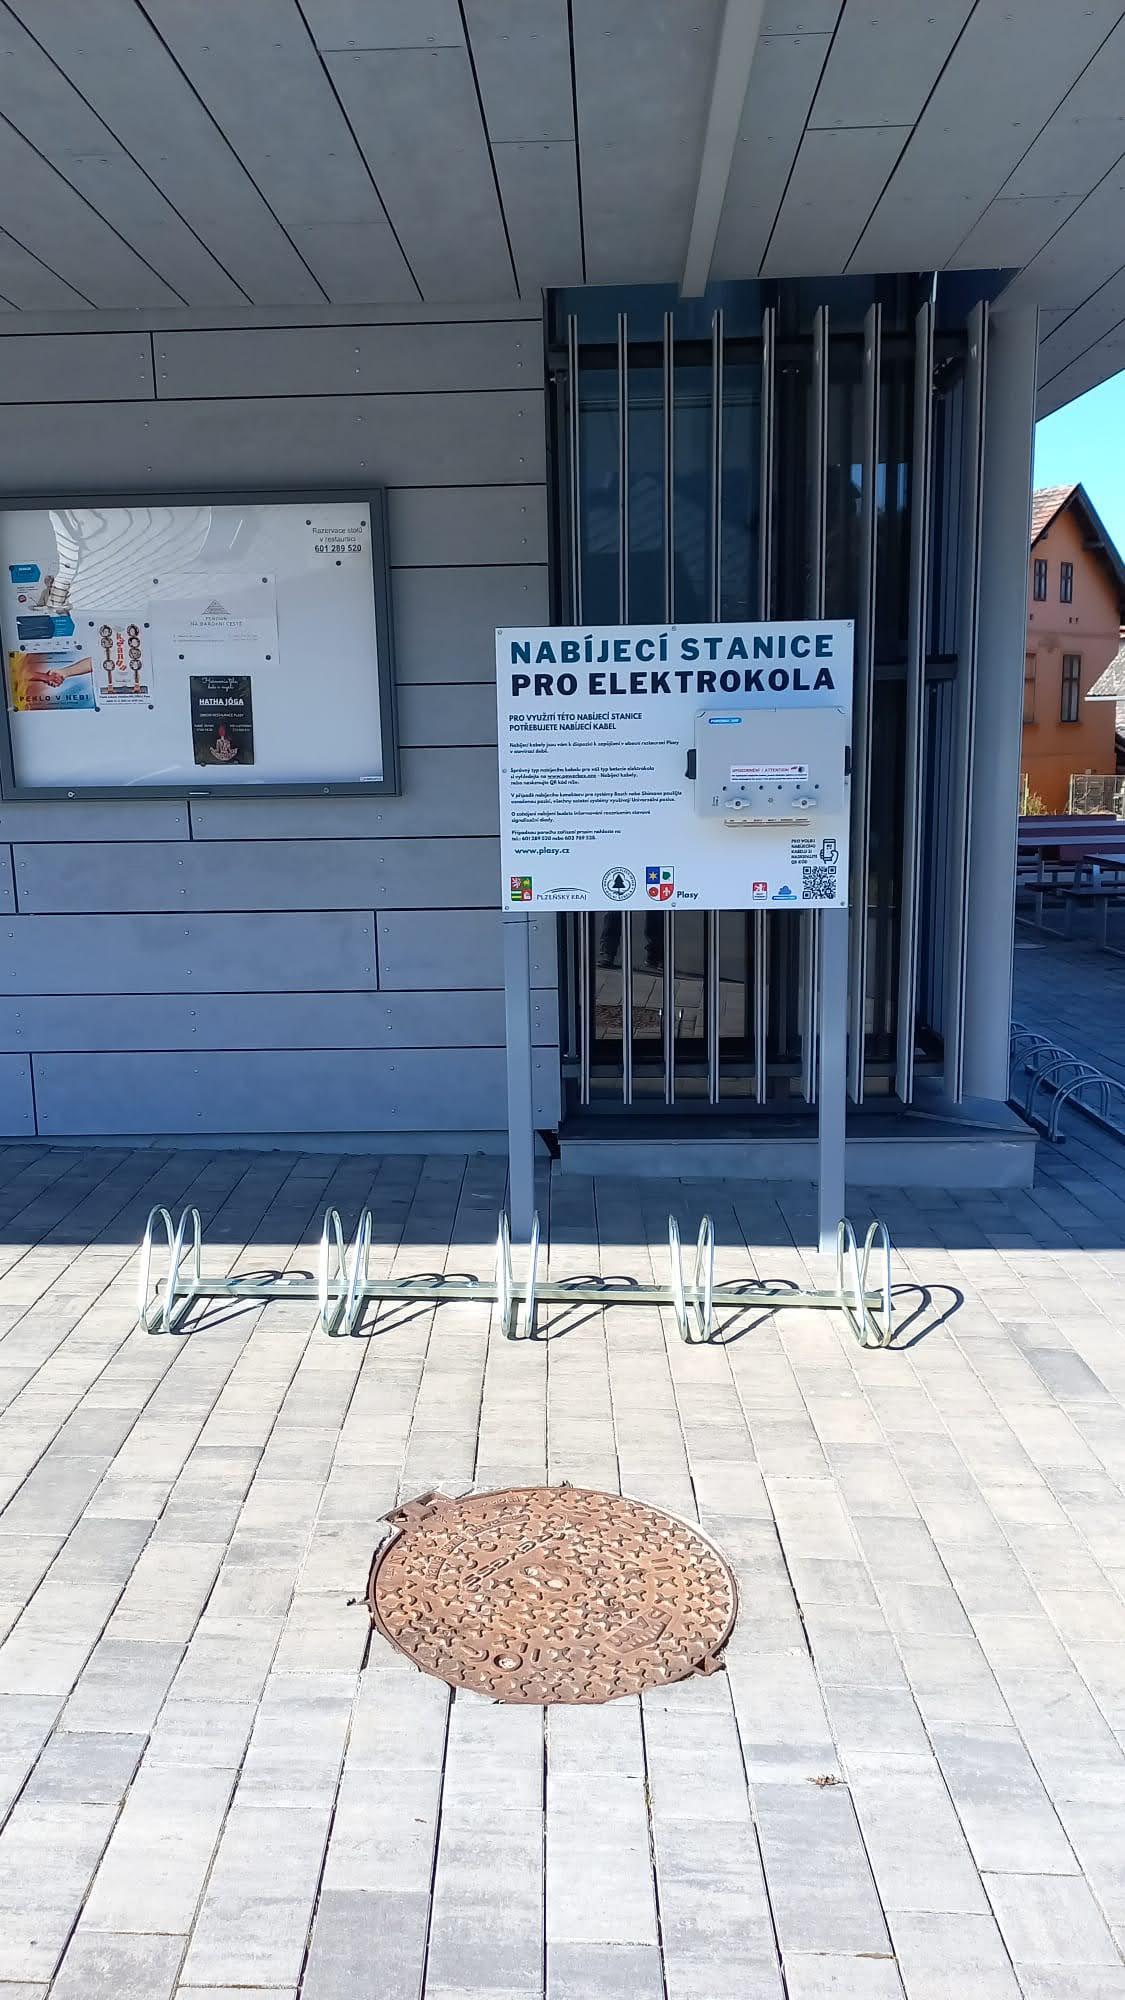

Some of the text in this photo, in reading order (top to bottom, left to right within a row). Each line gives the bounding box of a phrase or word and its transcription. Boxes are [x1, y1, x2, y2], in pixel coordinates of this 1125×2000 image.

[511, 633, 833, 664] NABÍJECÍ STANICE
[512, 668, 835, 696] PRO ELEKTROKOLA
[225, 697, 244, 706] JÓGA
[509, 712, 642, 722] PRO VYUŽITÍ TÉTO NABÍJECÍ STANICE
[514, 847, 570, 856] www.plasy.cz
[677, 890, 698, 900] Plasy
